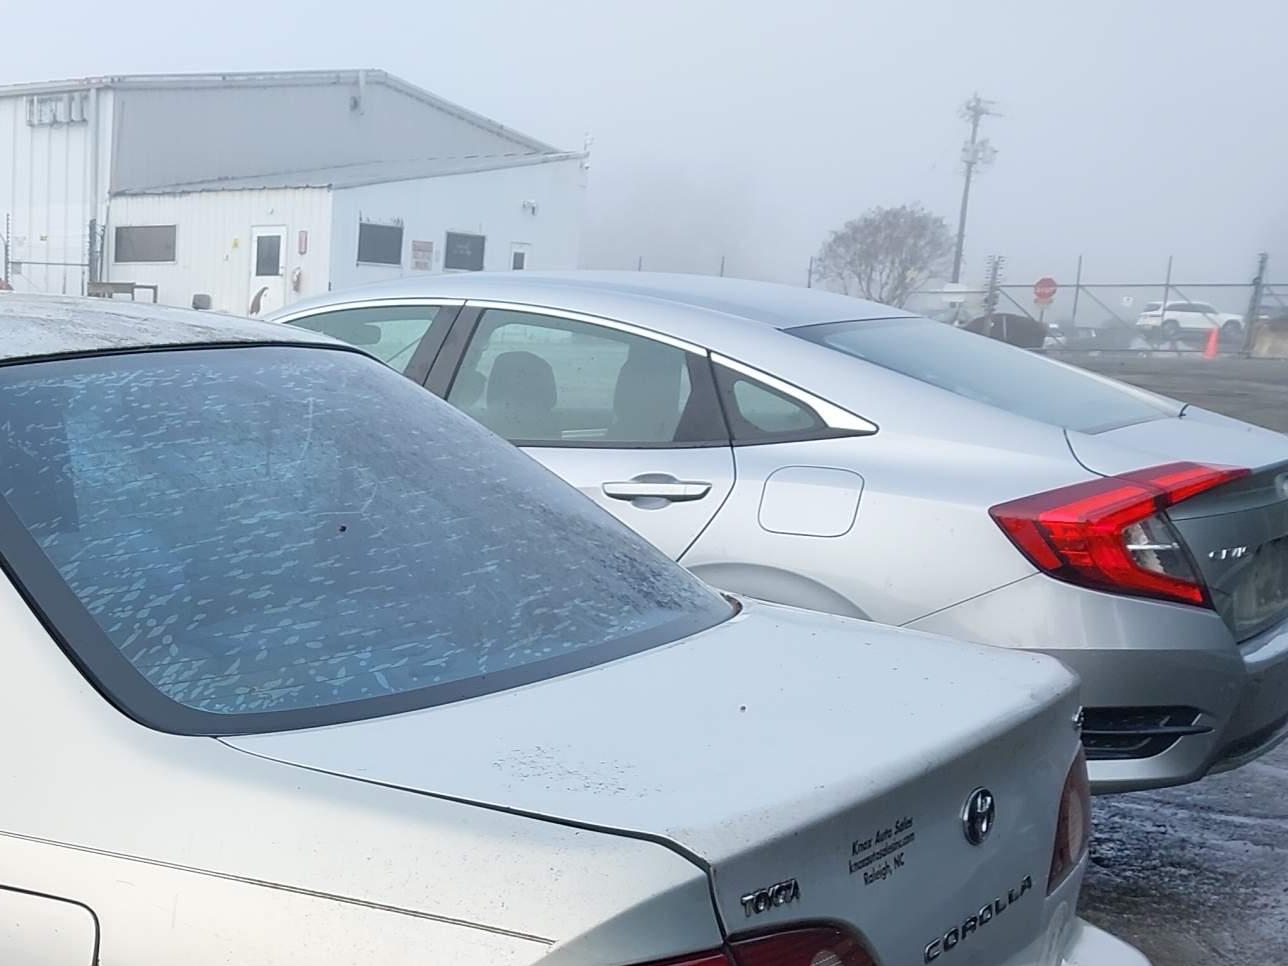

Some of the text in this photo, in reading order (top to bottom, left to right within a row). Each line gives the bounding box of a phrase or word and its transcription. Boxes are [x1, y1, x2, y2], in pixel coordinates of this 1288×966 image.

[852, 840, 872, 856] Knox
[875, 829, 892, 845] Auto
[893, 852, 905, 869] NC
[924, 874, 1032, 964] COROLLA
